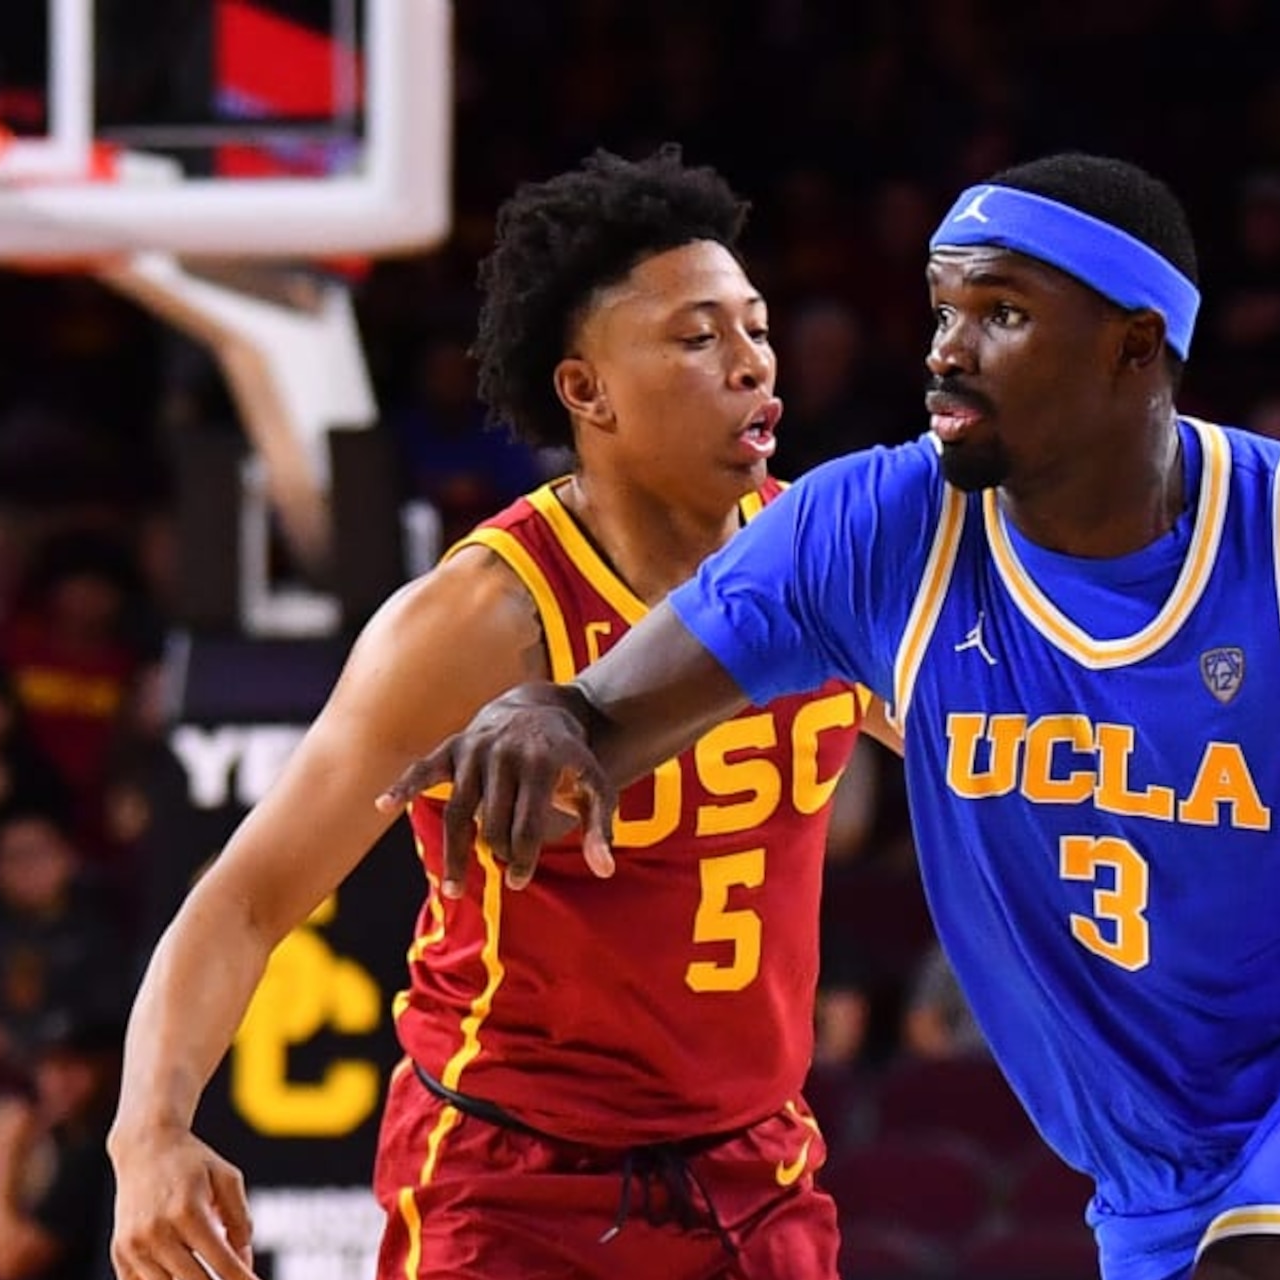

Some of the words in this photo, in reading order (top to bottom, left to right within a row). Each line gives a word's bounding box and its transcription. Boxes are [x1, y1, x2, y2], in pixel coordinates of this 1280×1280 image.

[1212, 672, 1234, 692] 12
[946, 712, 1271, 831] UCLA
[684, 847, 767, 993] 5
[1060, 835, 1150, 971] 3
